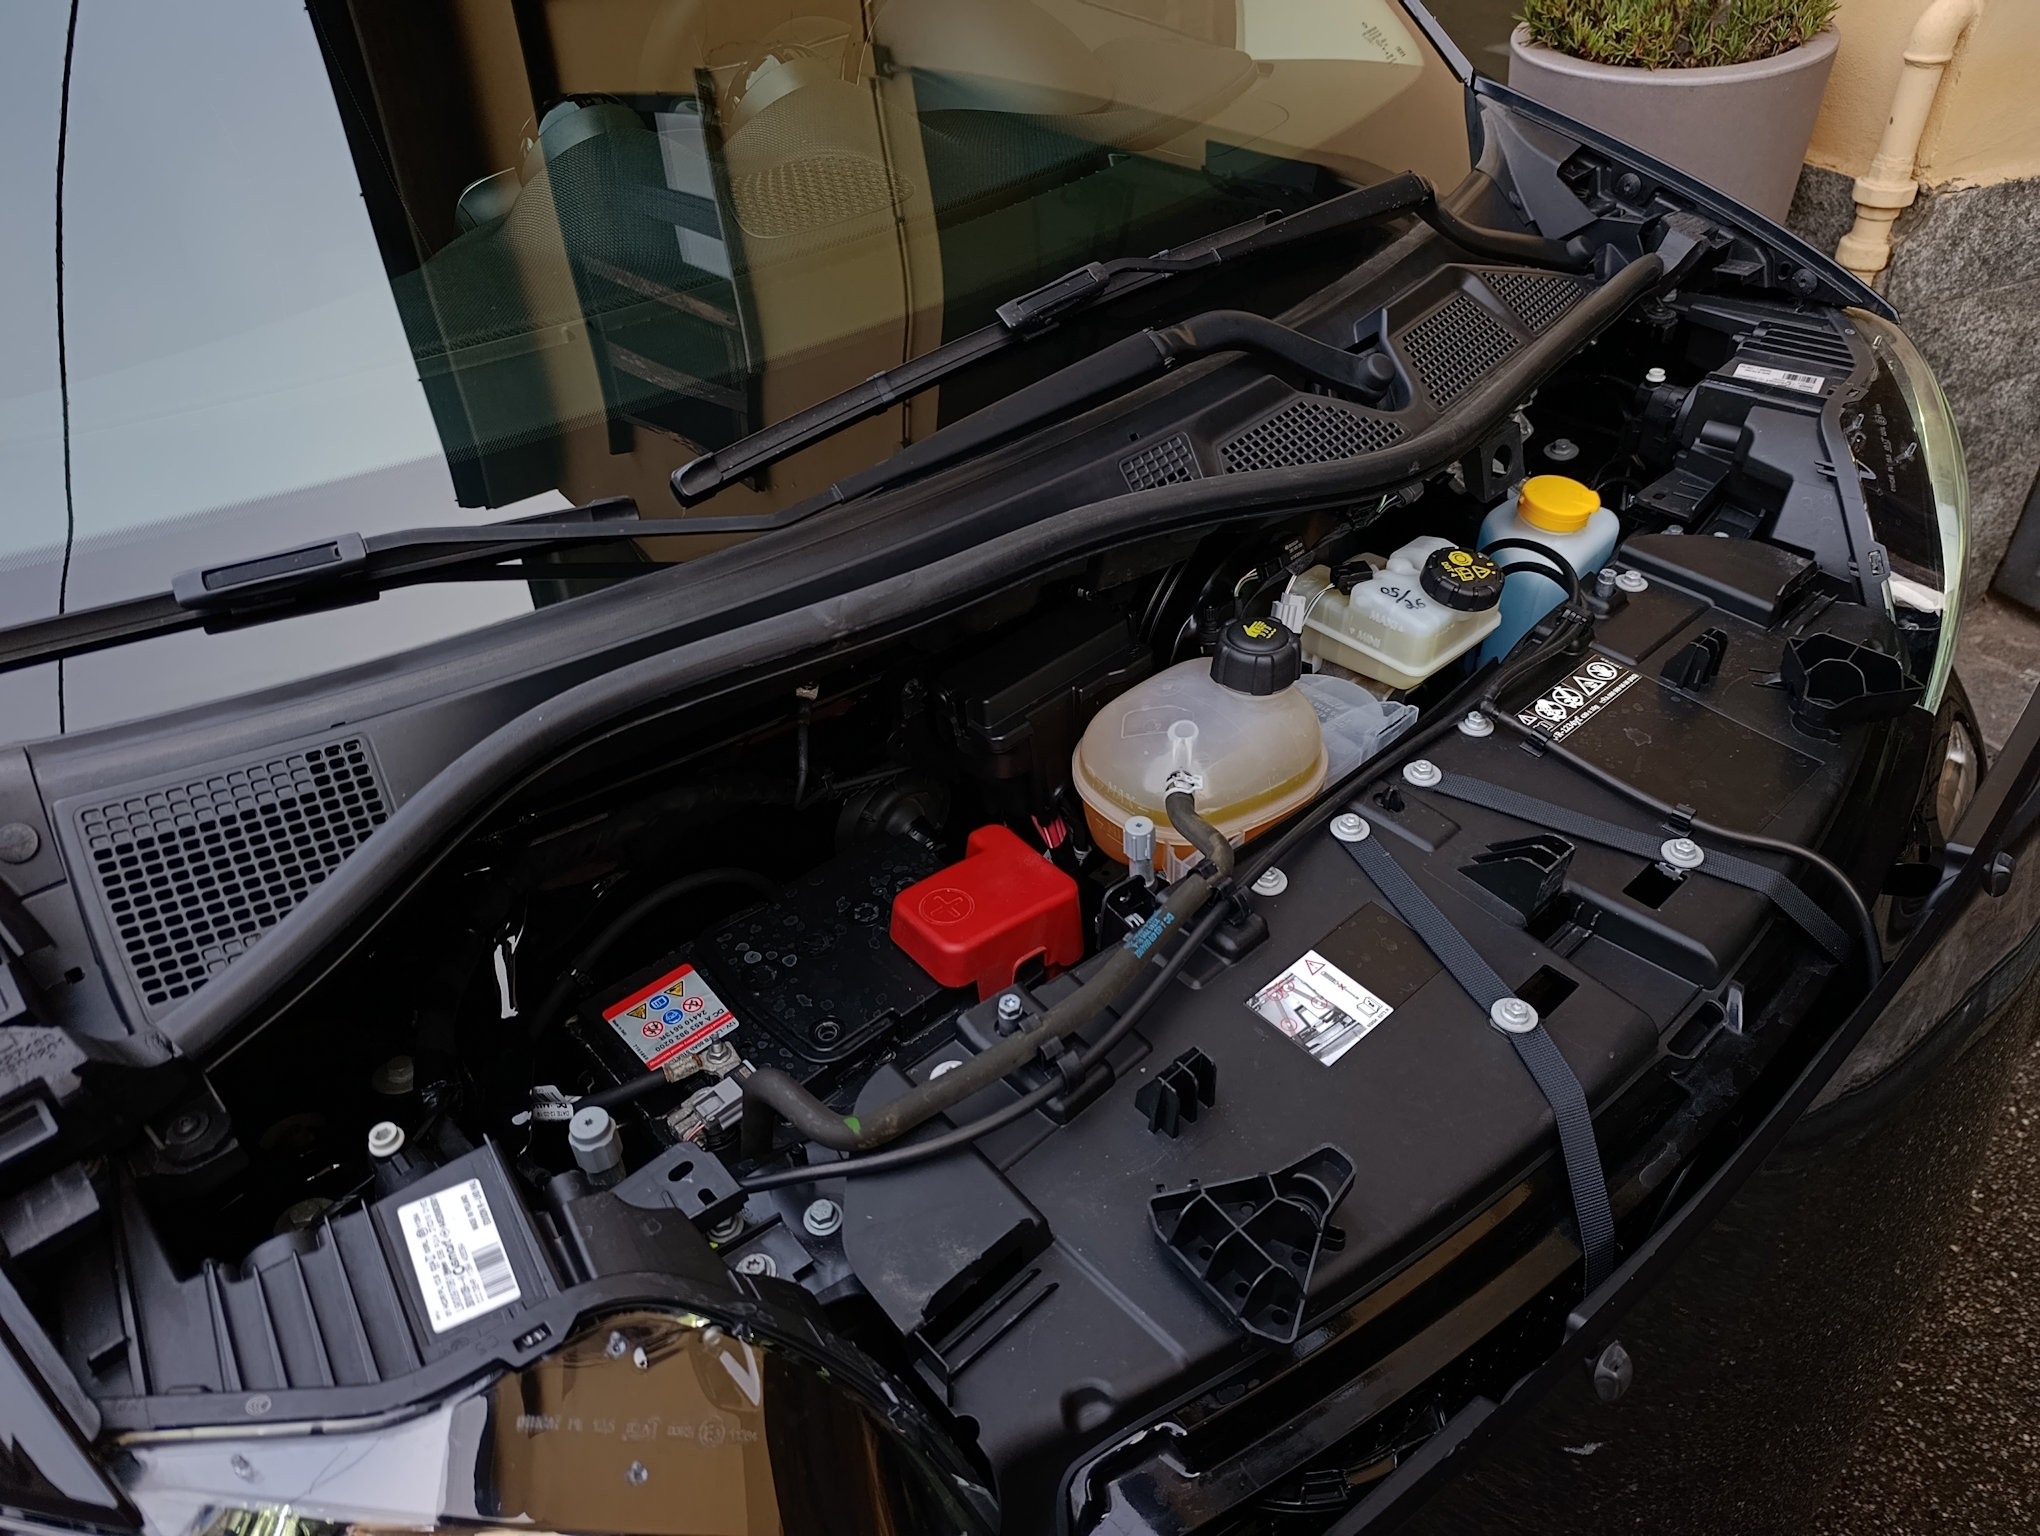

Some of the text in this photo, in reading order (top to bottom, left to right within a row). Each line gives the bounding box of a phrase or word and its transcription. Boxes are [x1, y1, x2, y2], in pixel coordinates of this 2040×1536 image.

[1441, 561, 1456, 574] DOT
[712, 1008, 725, 1018] DC
[658, 1009, 707, 1041] 24410 5613R
[689, 1020, 705, 1031] 453
[725, 1020, 736, 1029] 12V
[675, 1029, 690, 1040] 982
[655, 1038, 674, 1053] 0200
[441, 1238, 460, 1267] smart
